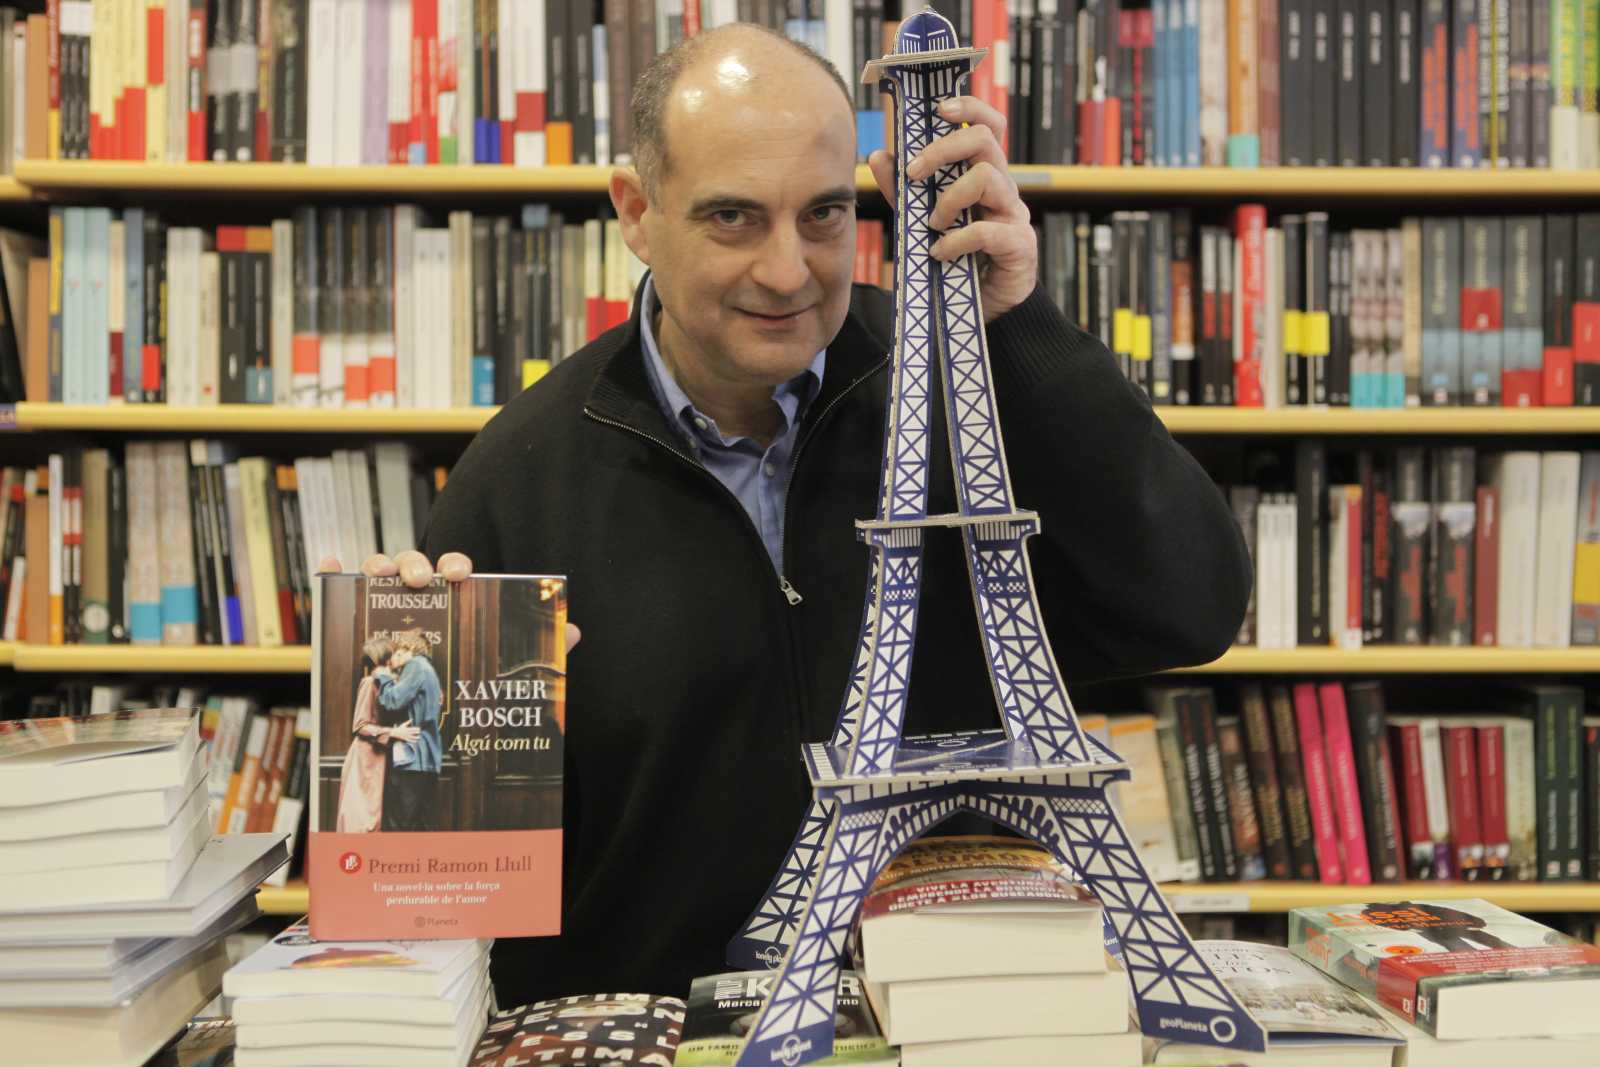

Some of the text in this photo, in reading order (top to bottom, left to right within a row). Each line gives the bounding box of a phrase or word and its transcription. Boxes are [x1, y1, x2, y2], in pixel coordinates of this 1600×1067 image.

[369, 593, 448, 609] TROUSSEAU
[455, 680, 547, 700] XAVIER
[459, 706, 542, 728] BOSCH
[448, 734, 551, 756] Algú com tu
[369, 855, 532, 874] Premi Ramon Llull
[373, 882, 393, 892] Una
[436, 881, 461, 891] sobre
[464, 881, 473, 891] la
[386, 895, 439, 908] perdurable
[441, 894, 453, 905] de
[427, 917, 458, 926] Planeta
